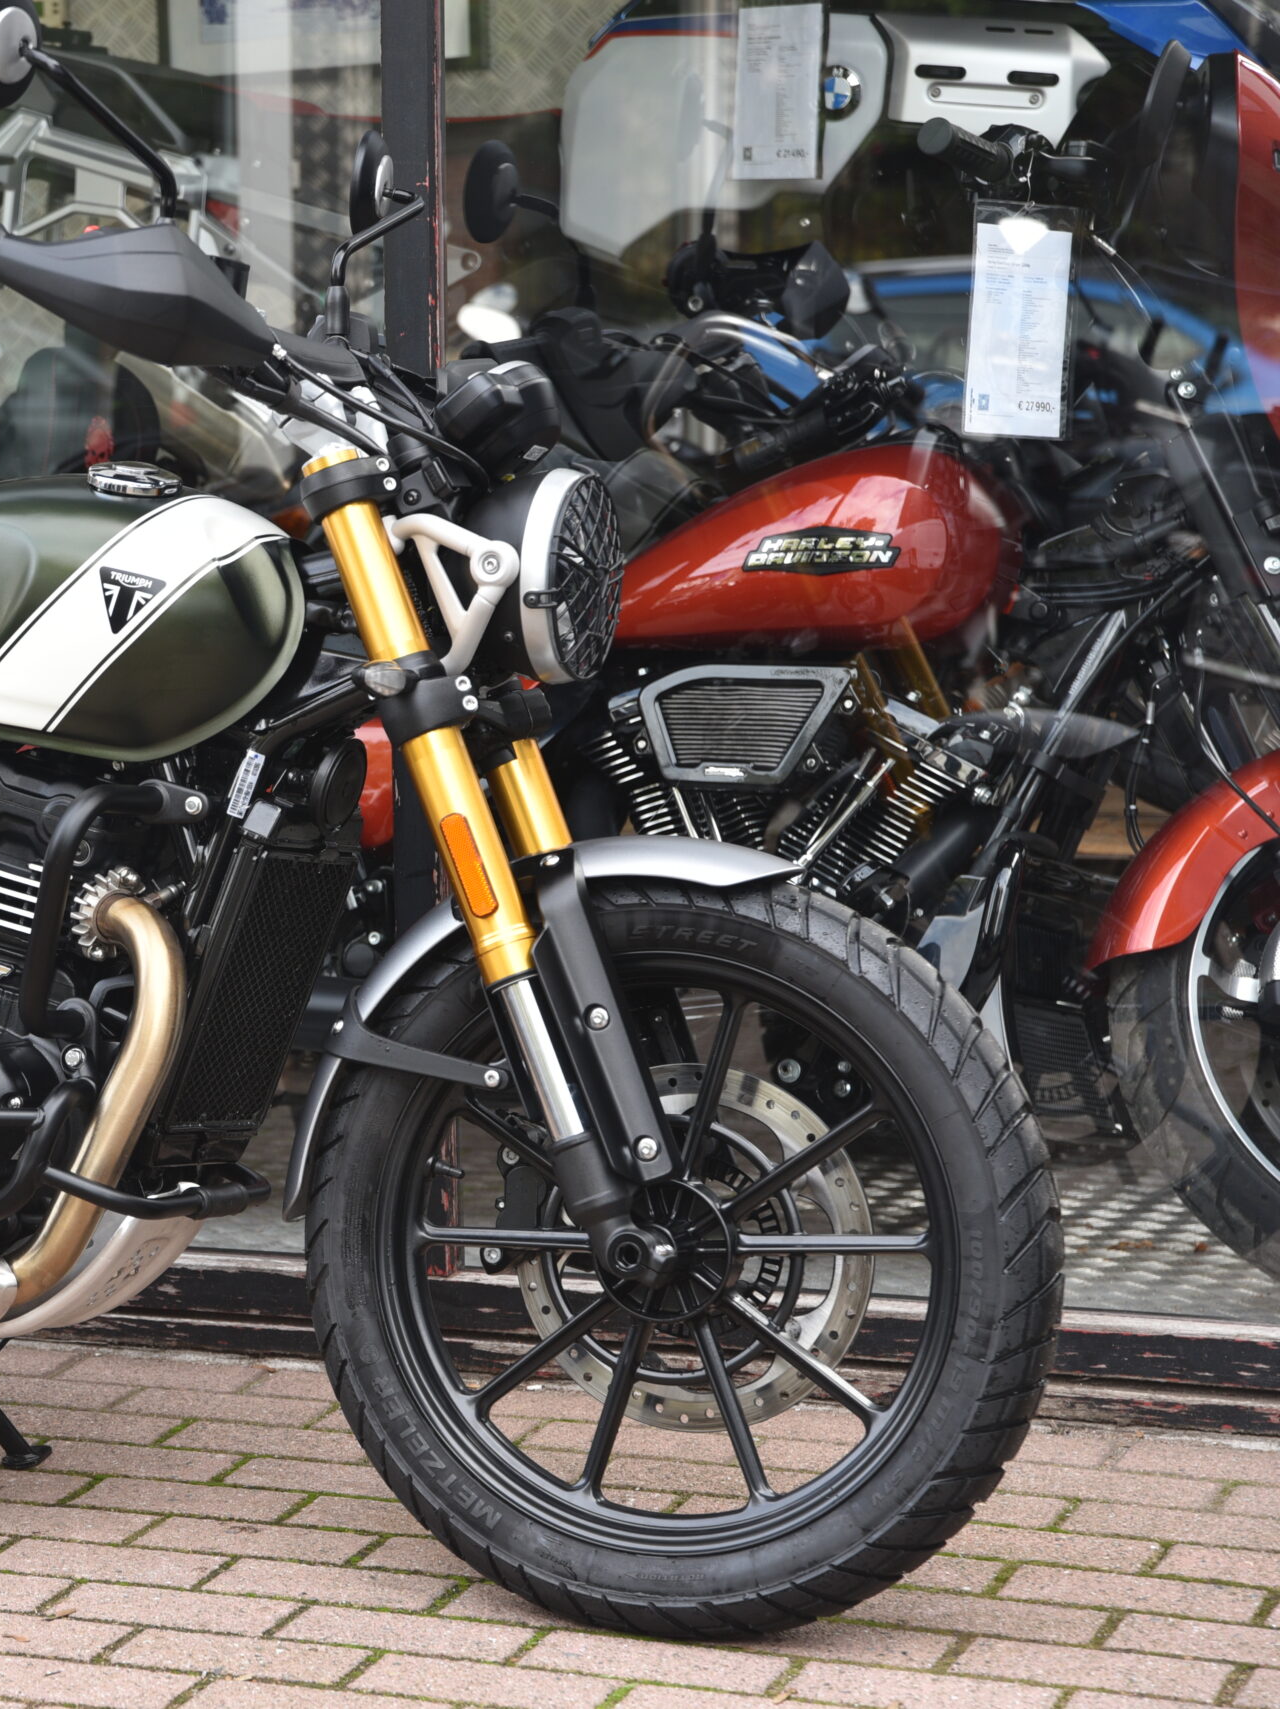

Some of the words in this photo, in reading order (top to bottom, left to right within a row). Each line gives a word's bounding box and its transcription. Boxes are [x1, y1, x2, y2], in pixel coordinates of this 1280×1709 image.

[1018, 400, 1024, 411] €
[748, 551, 892, 566] DAVIDSON
[110, 571, 153, 589] TRIUMPH
[628, 924, 759, 952] STREET
[371, 1375, 503, 1530] METZELER
